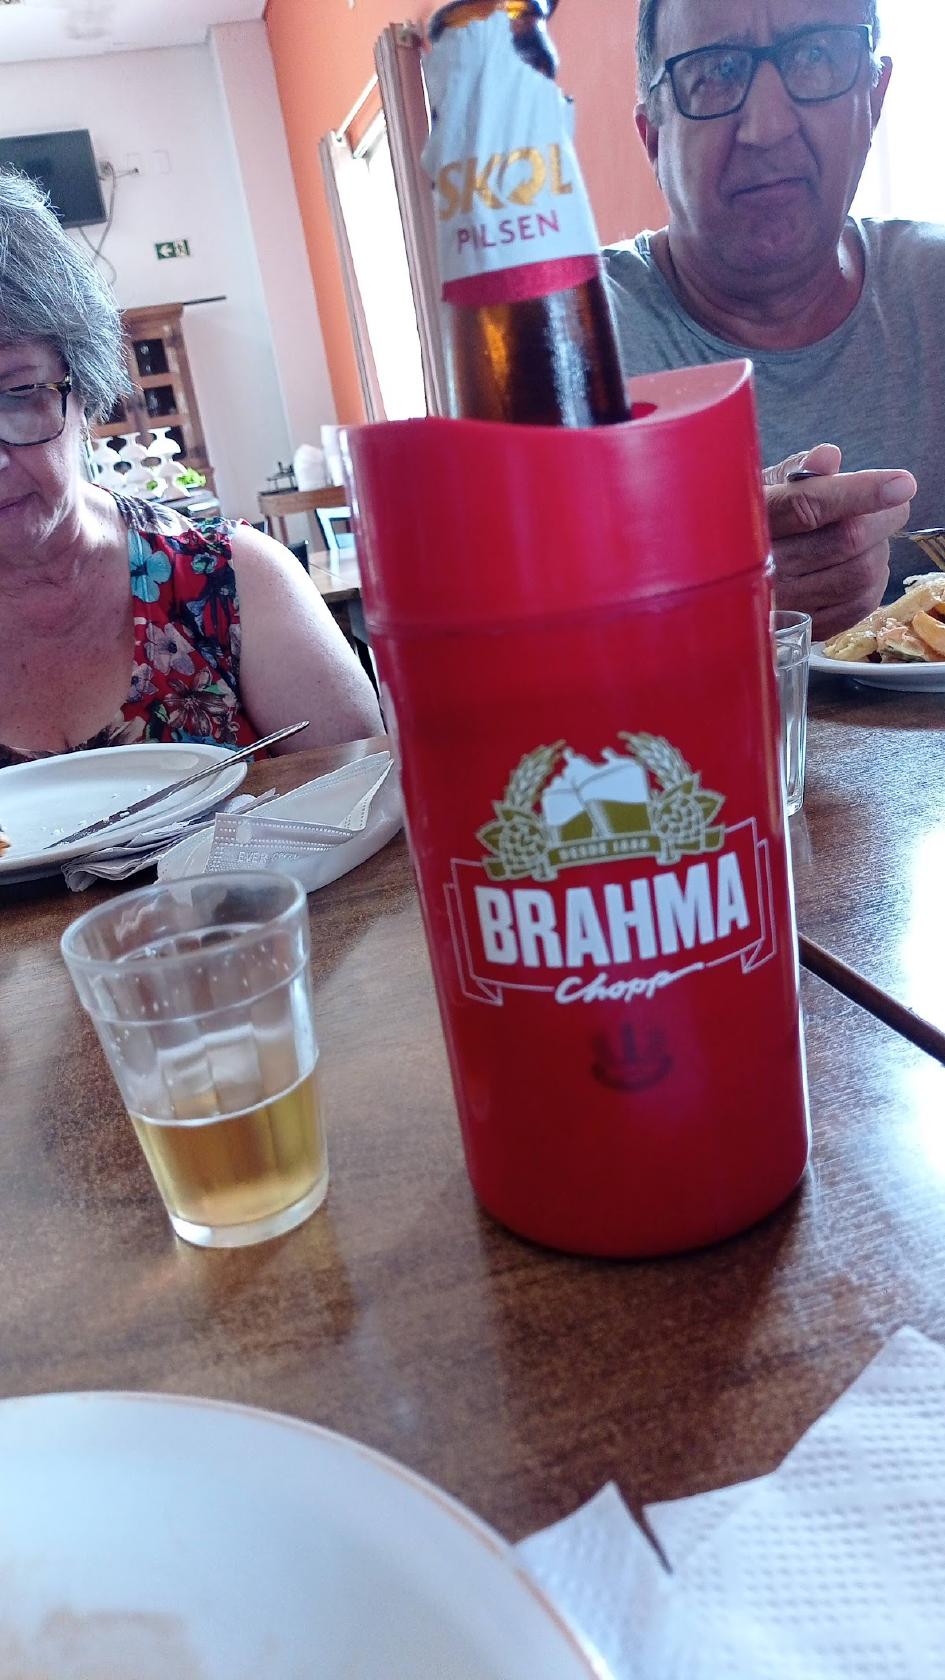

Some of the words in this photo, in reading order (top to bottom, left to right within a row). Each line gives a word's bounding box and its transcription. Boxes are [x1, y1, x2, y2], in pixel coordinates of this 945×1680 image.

[437, 143, 573, 221] SKOL
[457, 209, 560, 254] PILSEN
[475, 852, 750, 967] BRAHMA
[555, 962, 706, 1004] Chopp
